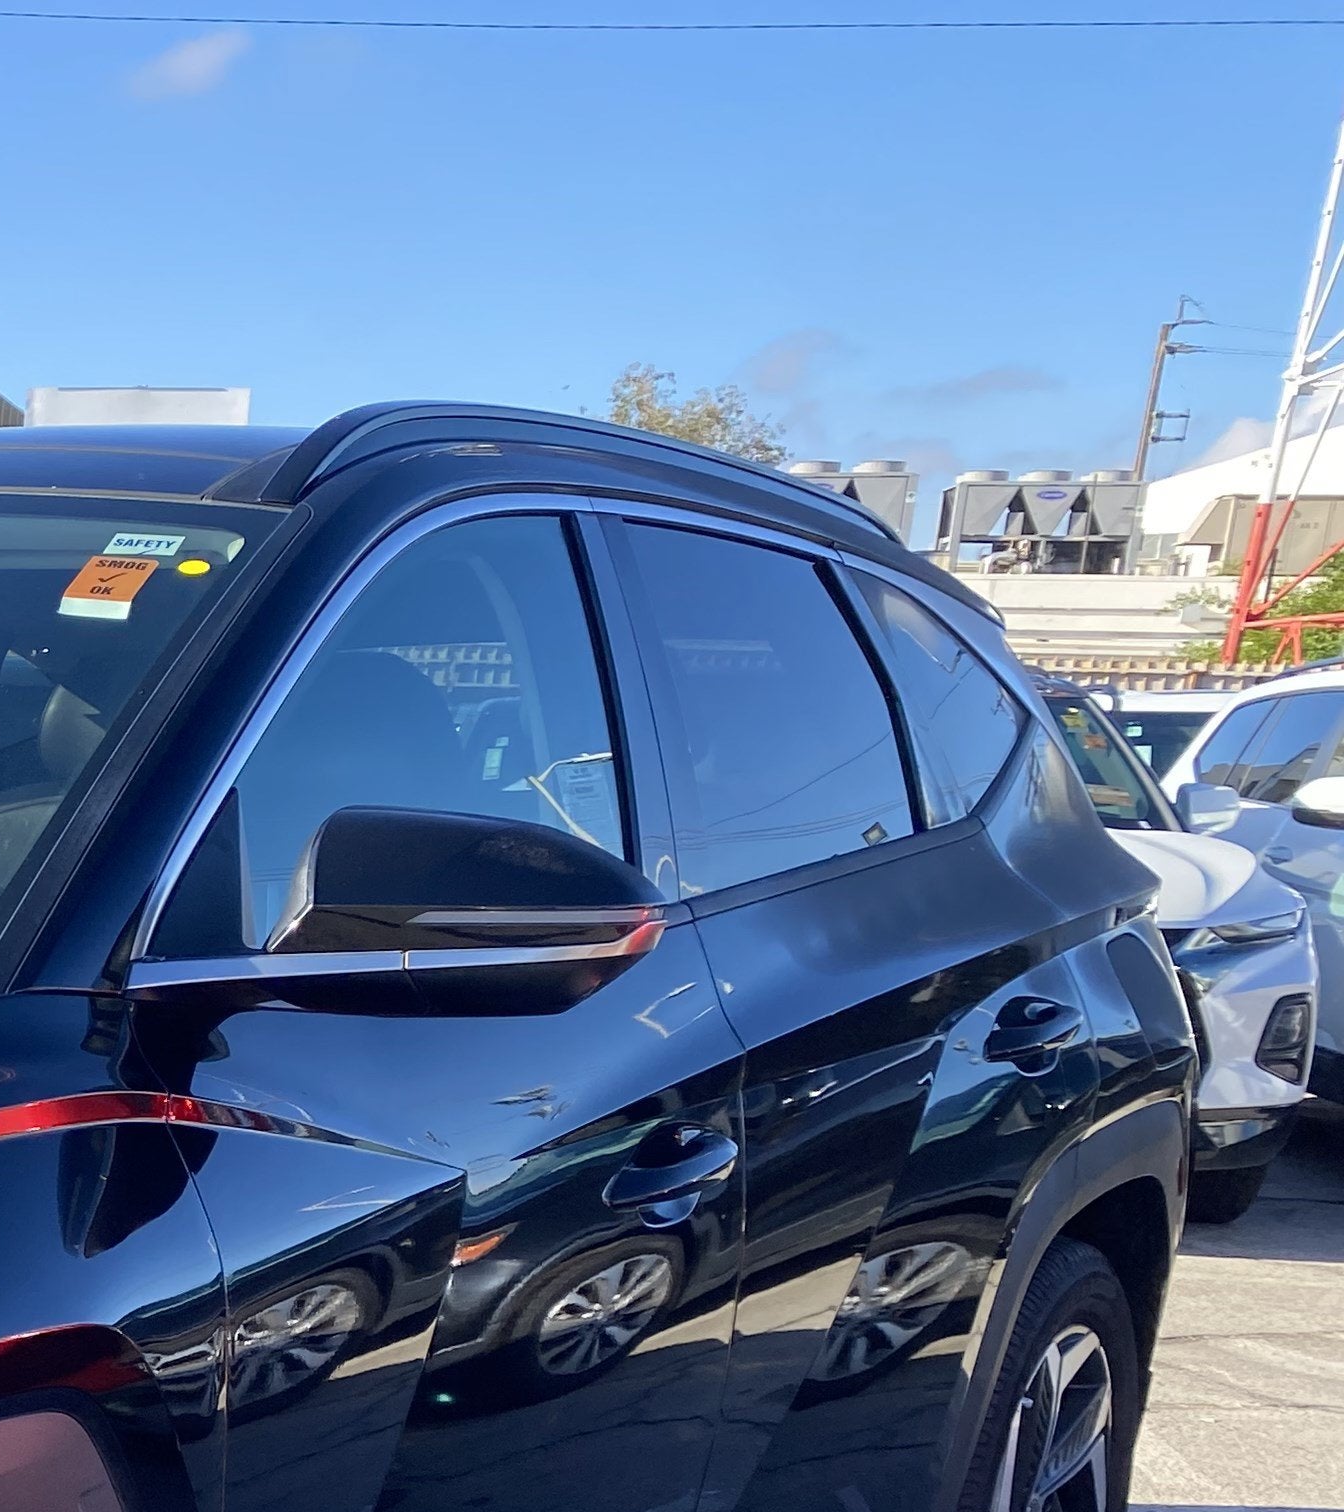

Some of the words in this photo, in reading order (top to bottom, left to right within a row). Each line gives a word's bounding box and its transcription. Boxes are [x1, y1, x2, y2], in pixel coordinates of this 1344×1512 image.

[113, 538, 177, 549] SAFETY
[95, 559, 150, 571] SMOG
[89, 585, 115, 595] OK
